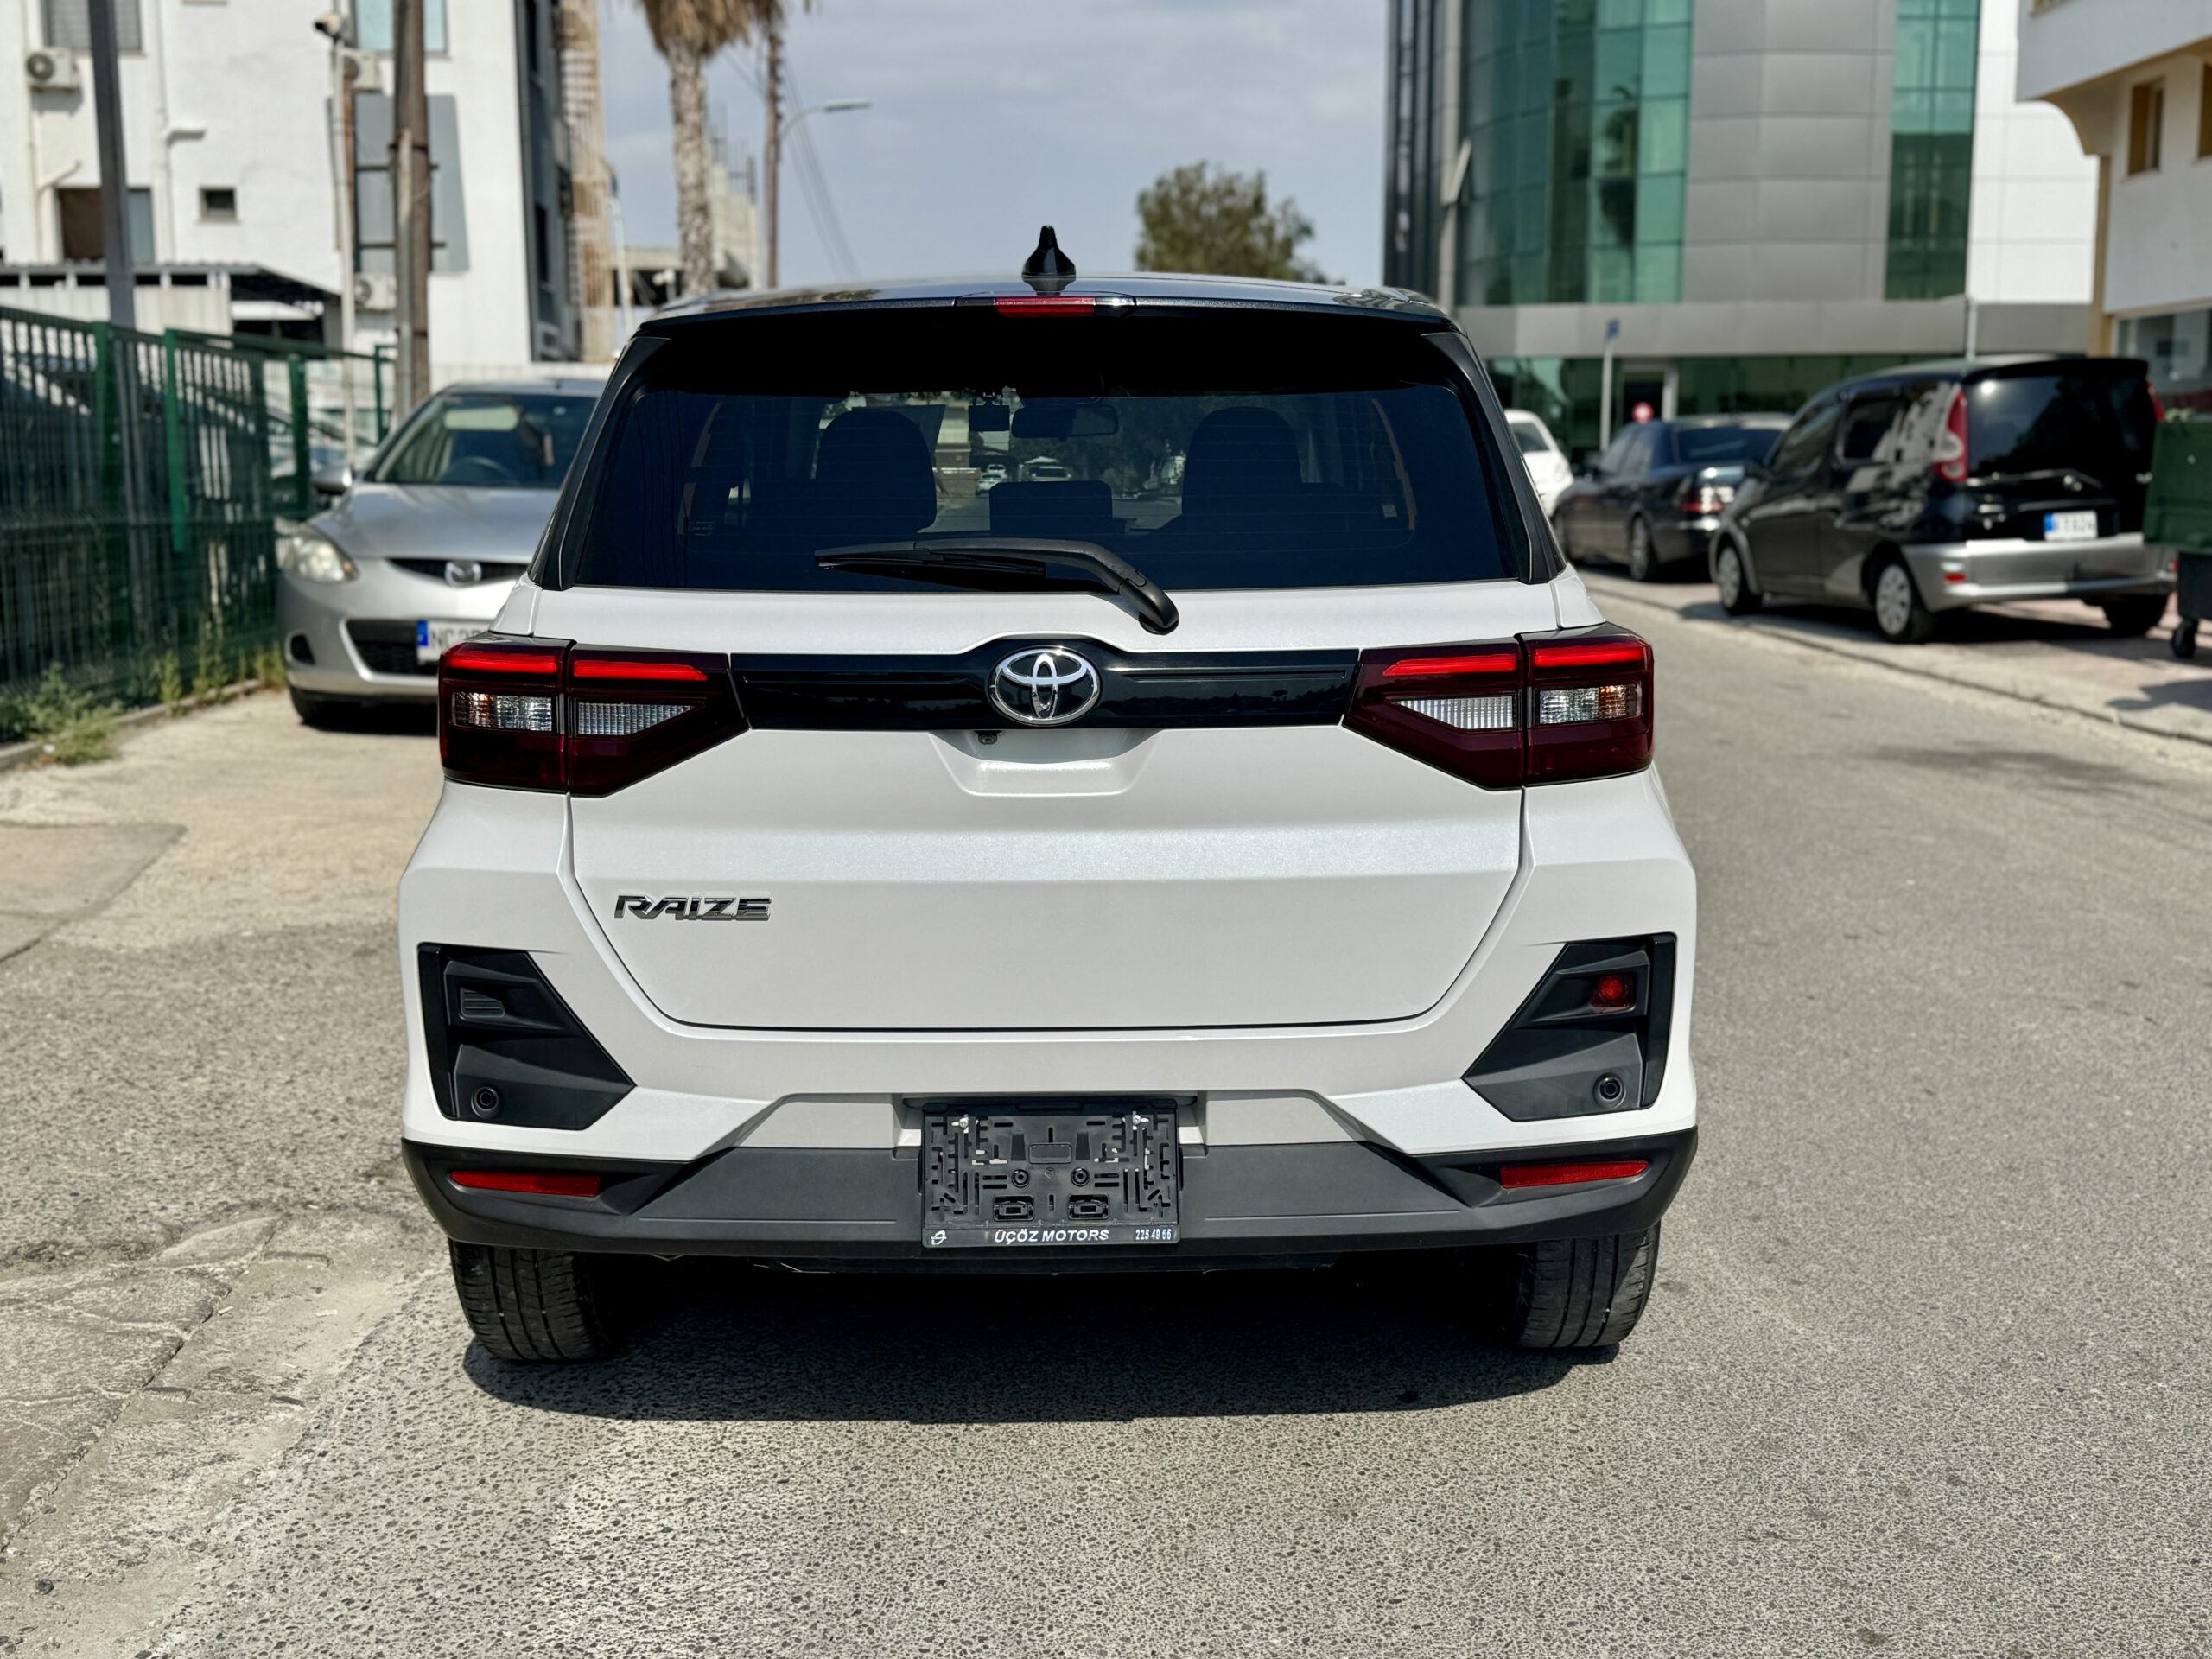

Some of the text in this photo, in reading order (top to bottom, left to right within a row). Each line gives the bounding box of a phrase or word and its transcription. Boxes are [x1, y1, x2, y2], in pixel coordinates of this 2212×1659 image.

[614, 895, 772, 921] RAIZE
[994, 1228, 1110, 1245] ÜÇÖZ MOTORS
